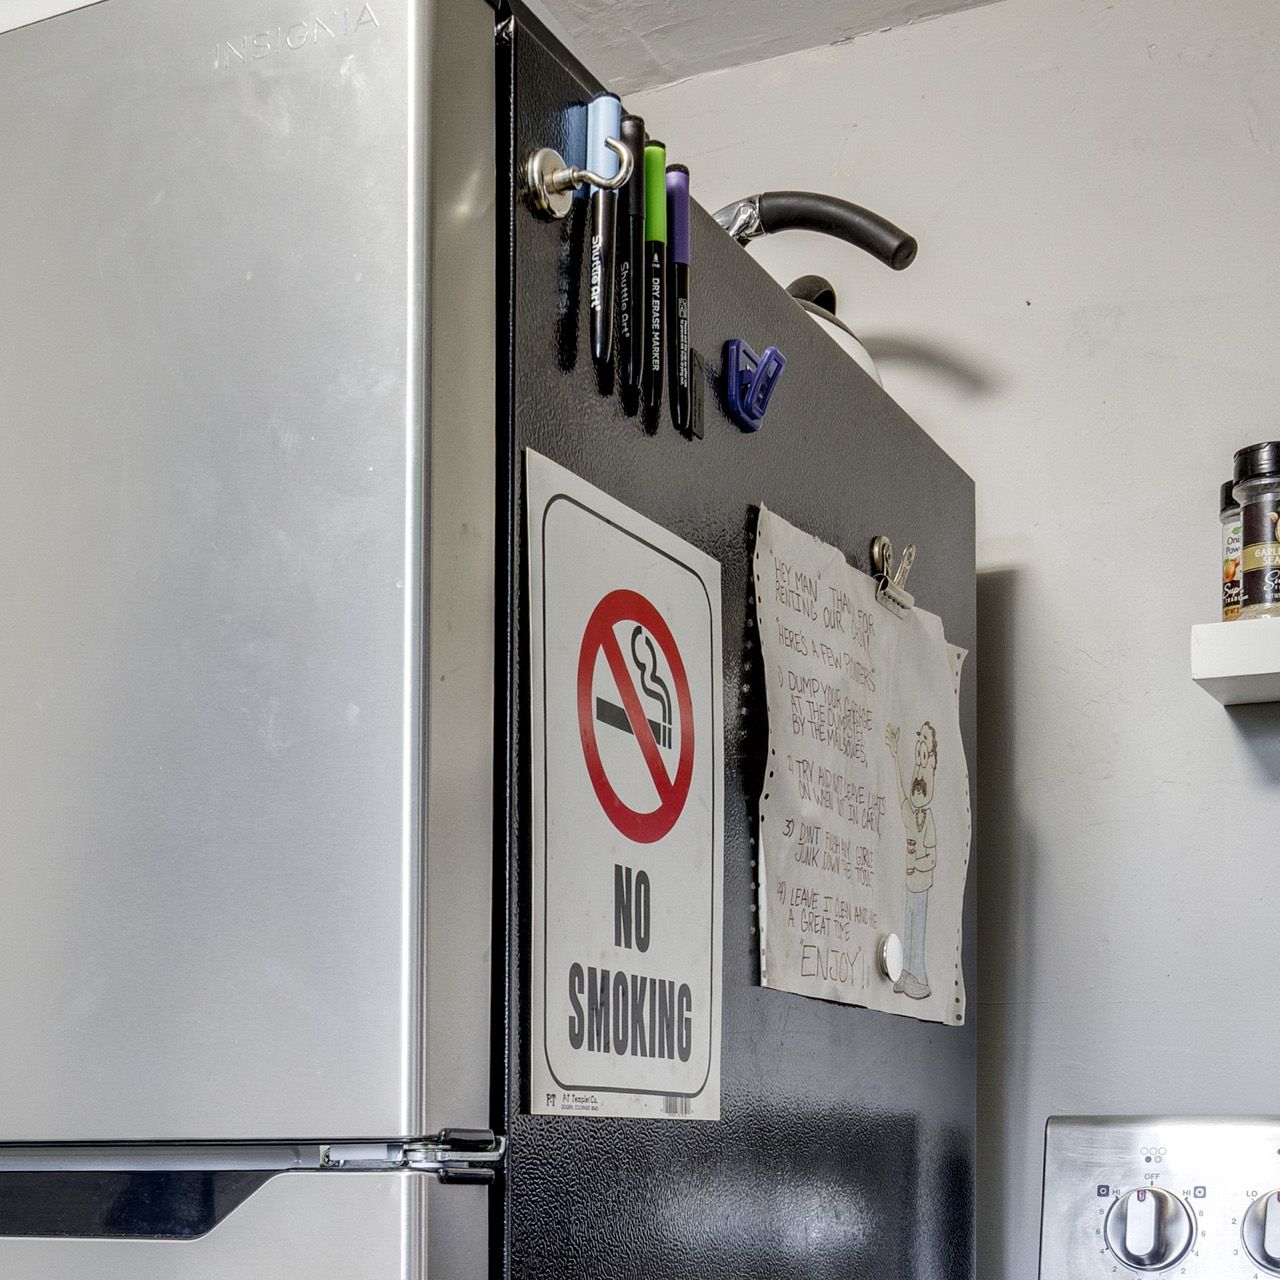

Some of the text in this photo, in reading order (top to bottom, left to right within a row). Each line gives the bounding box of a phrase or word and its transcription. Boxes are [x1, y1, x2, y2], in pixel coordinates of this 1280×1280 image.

[212, 1, 380, 70] INSIGNIA
[591, 235, 602, 284] Shuttle
[620, 261, 630, 311] Shuttle
[652, 278, 661, 298] DRY
[652, 300, 661, 329] ERASE
[652, 331, 661, 371] MARKER
[775, 580, 817, 621] RENTING
[823, 607, 844, 632] OUR
[812, 640, 819, 658] A
[820, 643, 842, 670] FEW
[788, 671, 819, 698] DUMP
[791, 694, 802, 716] AT
[805, 700, 825, 721] THE
[793, 715, 805, 736] BY
[808, 720, 826, 742] THE
[795, 759, 814, 783] TRY
[799, 779, 811, 801] ON
[782, 818, 795, 838] 3)
[795, 847, 819, 868] JUNK
[615, 864, 650, 953] NO
[790, 888, 820, 910] LEAVE
[787, 907, 831, 936] A GREAT
[569, 962, 692, 1062] SMOKING
